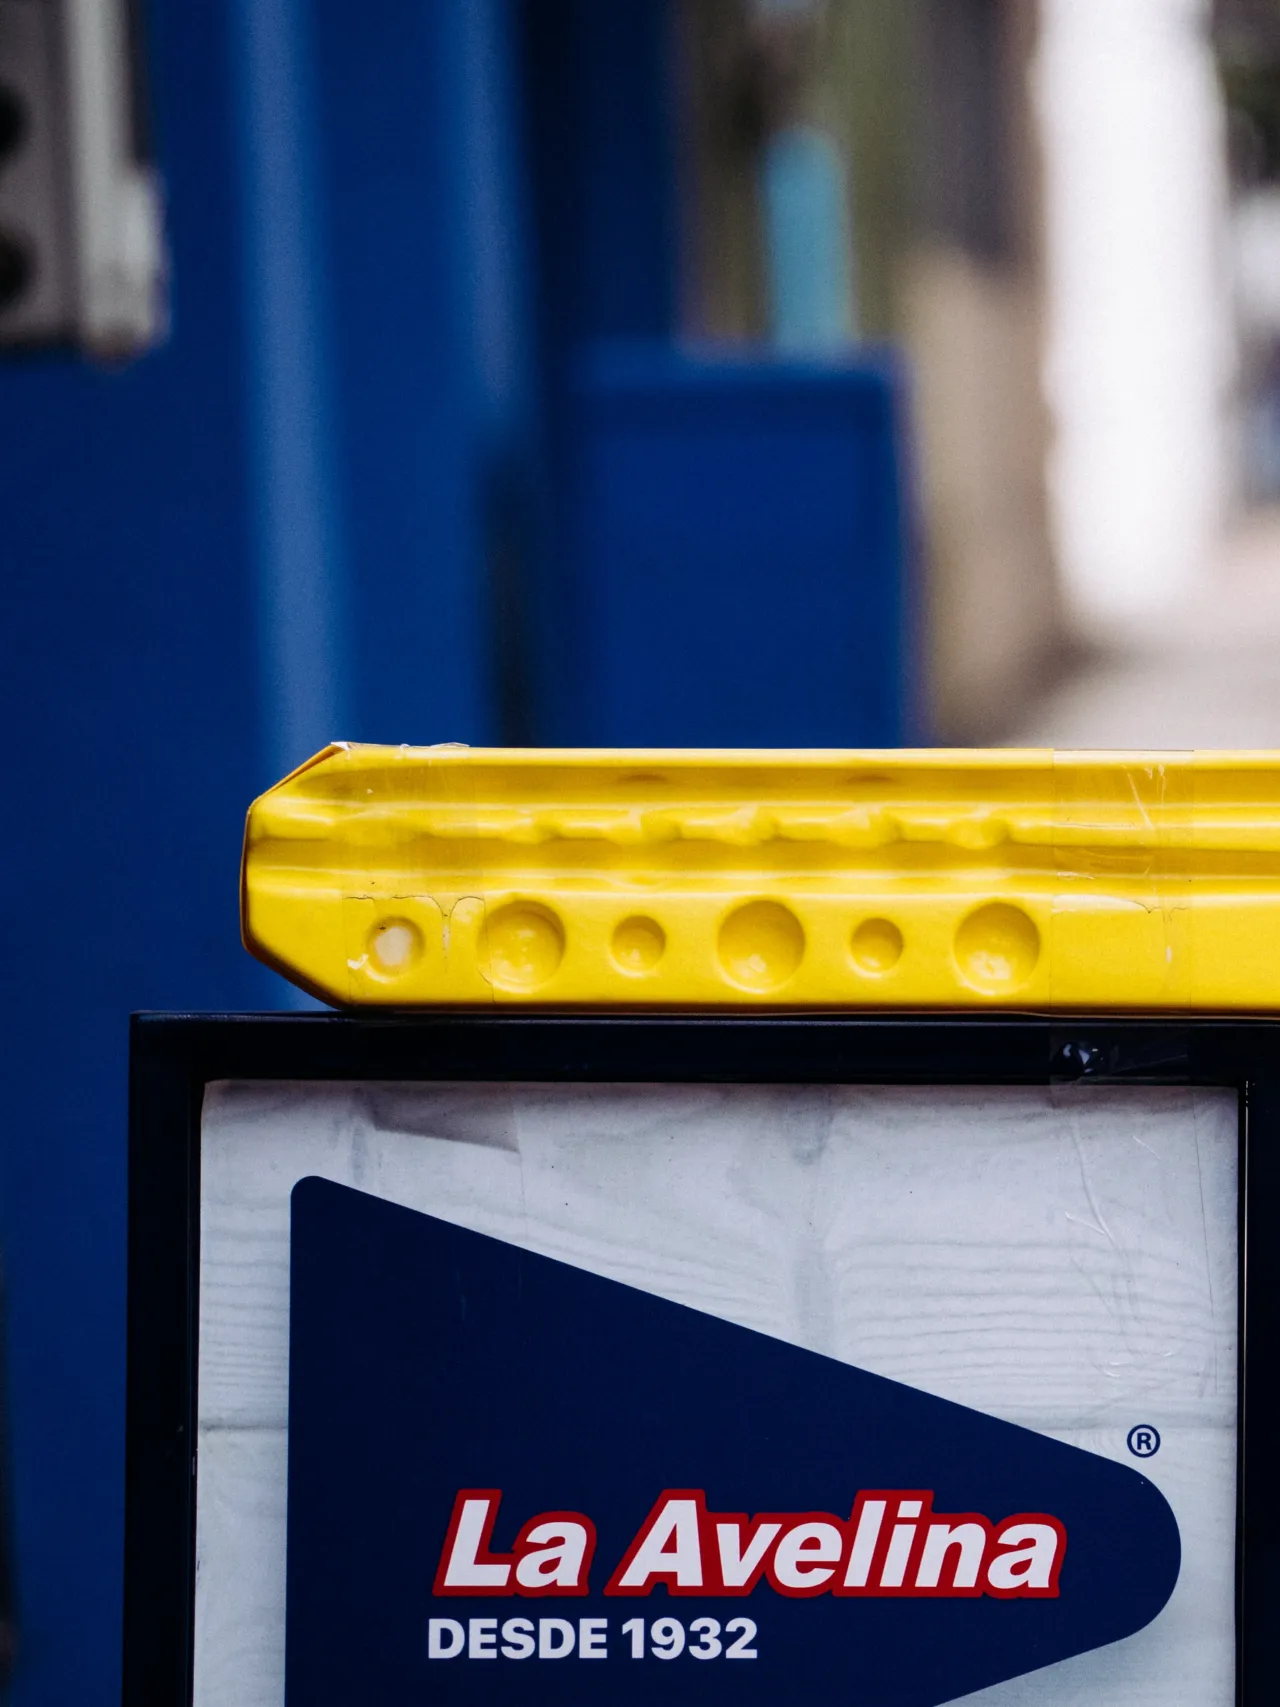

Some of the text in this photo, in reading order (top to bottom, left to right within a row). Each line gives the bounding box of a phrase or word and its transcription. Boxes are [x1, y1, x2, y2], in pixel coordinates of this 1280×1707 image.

[440, 1495, 1062, 1592] La Avelina
[428, 1617, 757, 1660] DESDE 1932
